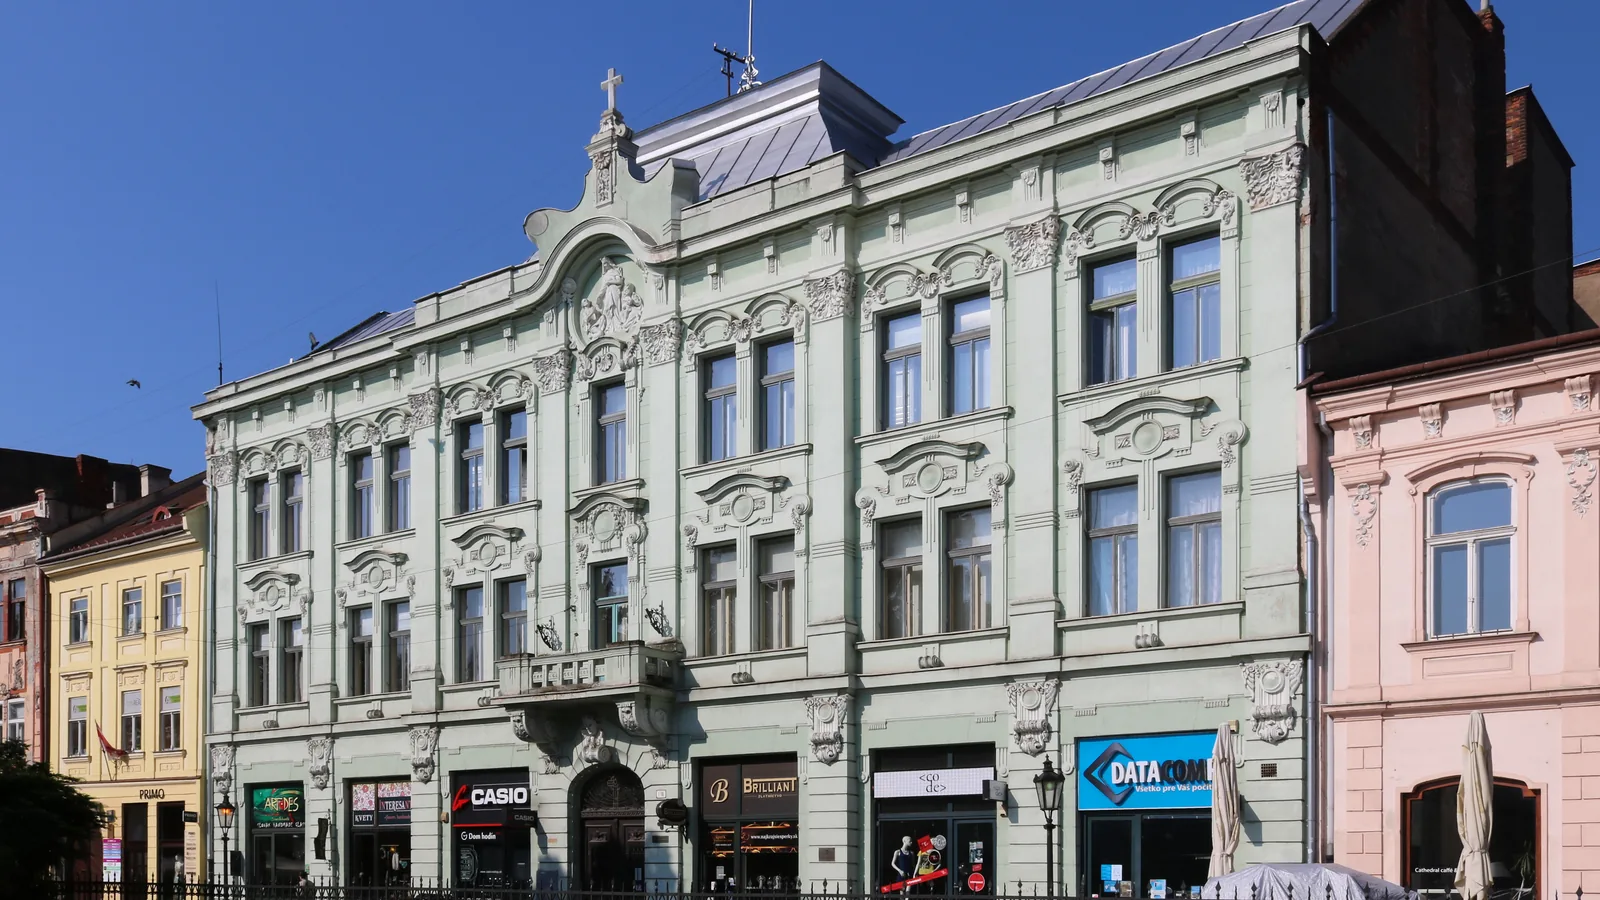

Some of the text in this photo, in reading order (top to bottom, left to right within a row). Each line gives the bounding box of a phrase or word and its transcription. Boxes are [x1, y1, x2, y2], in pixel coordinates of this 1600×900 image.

[710, 778, 729, 803] B
[743, 776, 798, 794] BRILLIANT
[1162, 785, 1176, 793] pre
[1176, 783, 1191, 791] Váš
[139, 788, 165, 800] PRIMO
[471, 787, 528, 805] CASIO
[354, 814, 374, 822] KVETY
[468, 832, 480, 840] Dom
